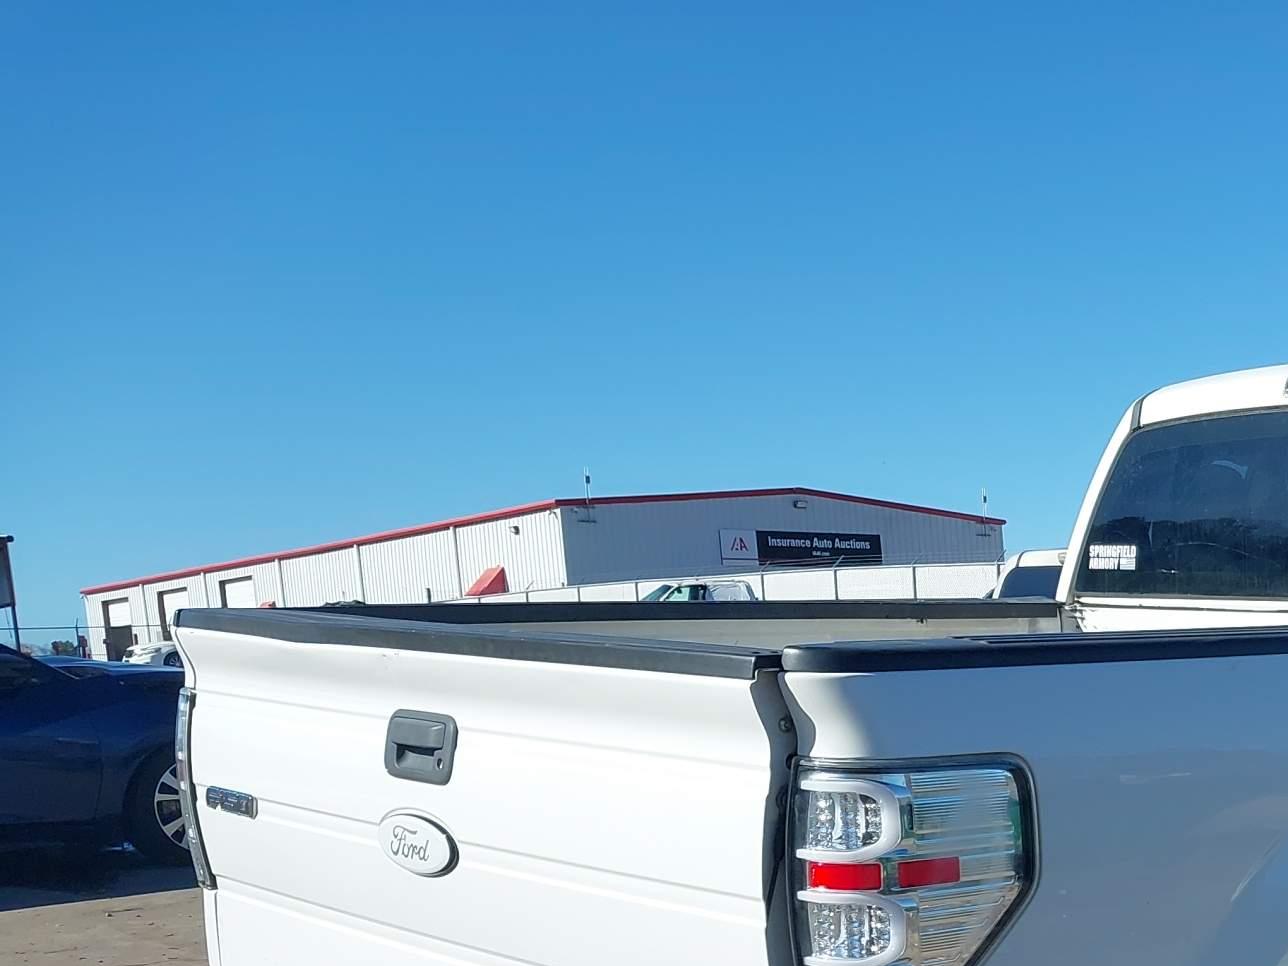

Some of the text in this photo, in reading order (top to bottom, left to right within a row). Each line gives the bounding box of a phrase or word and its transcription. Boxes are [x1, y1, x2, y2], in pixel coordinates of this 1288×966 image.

[768, 536, 871, 550] Insurance Auto Auctions
[1089, 545, 1136, 557] SPRINGFIELD
[1089, 558, 1118, 569] ARMORY
[391, 825, 430, 861] Ford
